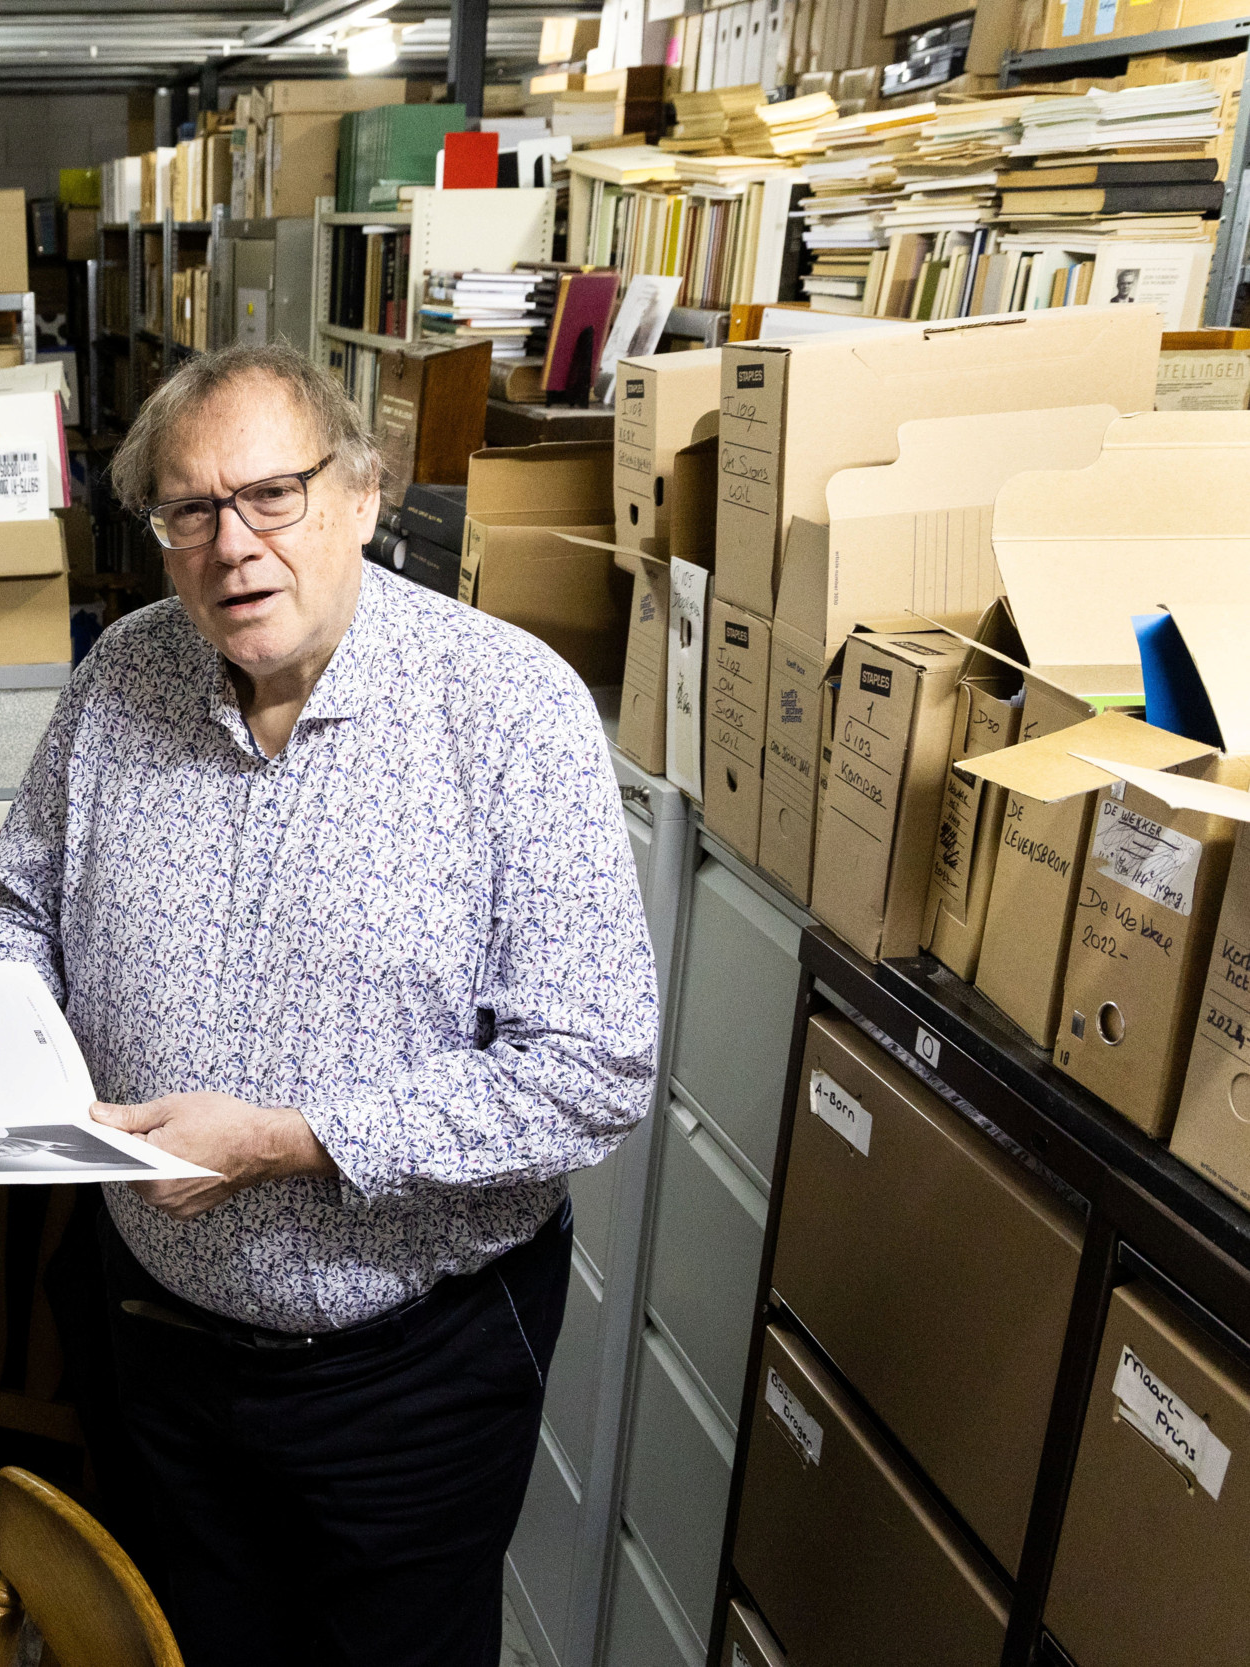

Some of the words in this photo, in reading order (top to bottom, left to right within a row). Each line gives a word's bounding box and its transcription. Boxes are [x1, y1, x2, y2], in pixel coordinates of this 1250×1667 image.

[738, 369, 763, 382] STAPLES
[726, 627, 748, 642] STAPLES
[862, 670, 890, 690] STAPLES
[781, 688, 798, 700] Loeff's
[781, 714, 802, 724] systems
[785, 706, 804, 716] archive
[1007, 798, 1025, 822] DE
[1104, 802, 1118, 816] DE
[1121, 810, 1162, 838] WEKKER
[1078, 886, 1108, 917] De
[814, 1082, 855, 1123] A-Born
